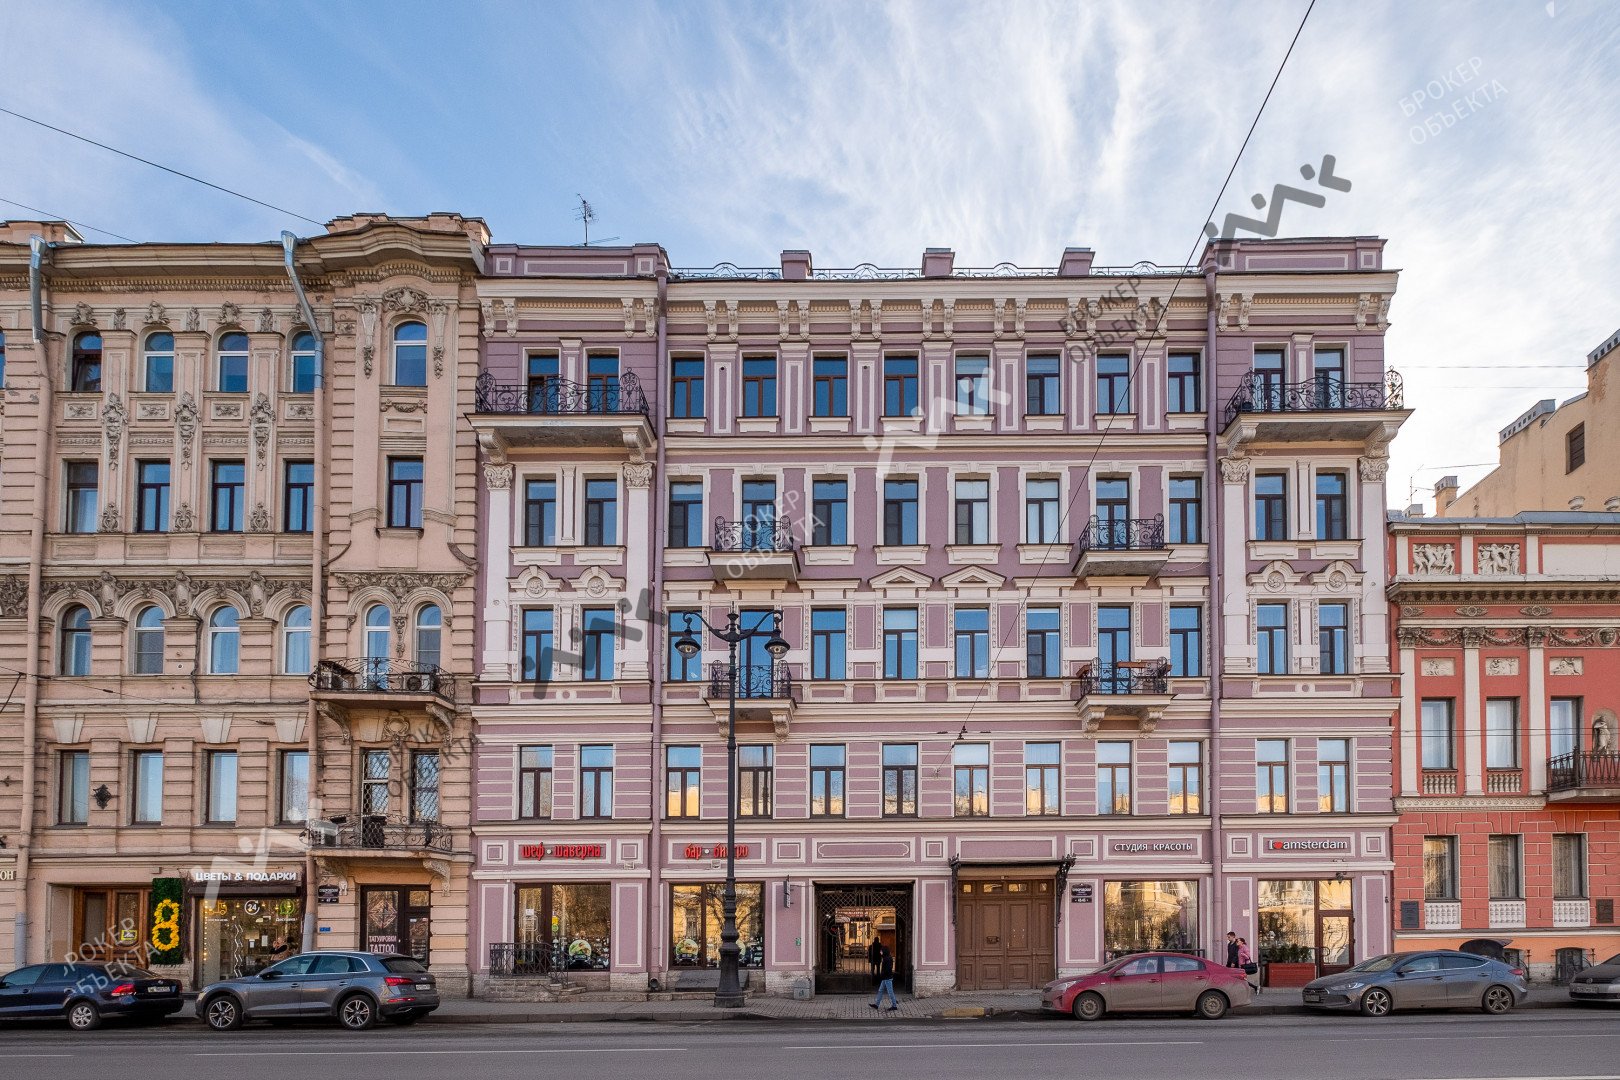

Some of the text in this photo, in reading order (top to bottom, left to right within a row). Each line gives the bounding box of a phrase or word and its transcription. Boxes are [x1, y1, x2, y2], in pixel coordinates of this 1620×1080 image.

[1114, 842, 1193, 852] СТУДИЯ КРАСОТЫ
[1283, 840, 1348, 850] amsterdam
[522, 842, 601, 861] шеф шаверма
[684, 842, 749, 860] бар биро
[195, 872, 297, 882] ЦВЕТЫ & ПОДАРКИ
[246, 903, 257, 911] 24
